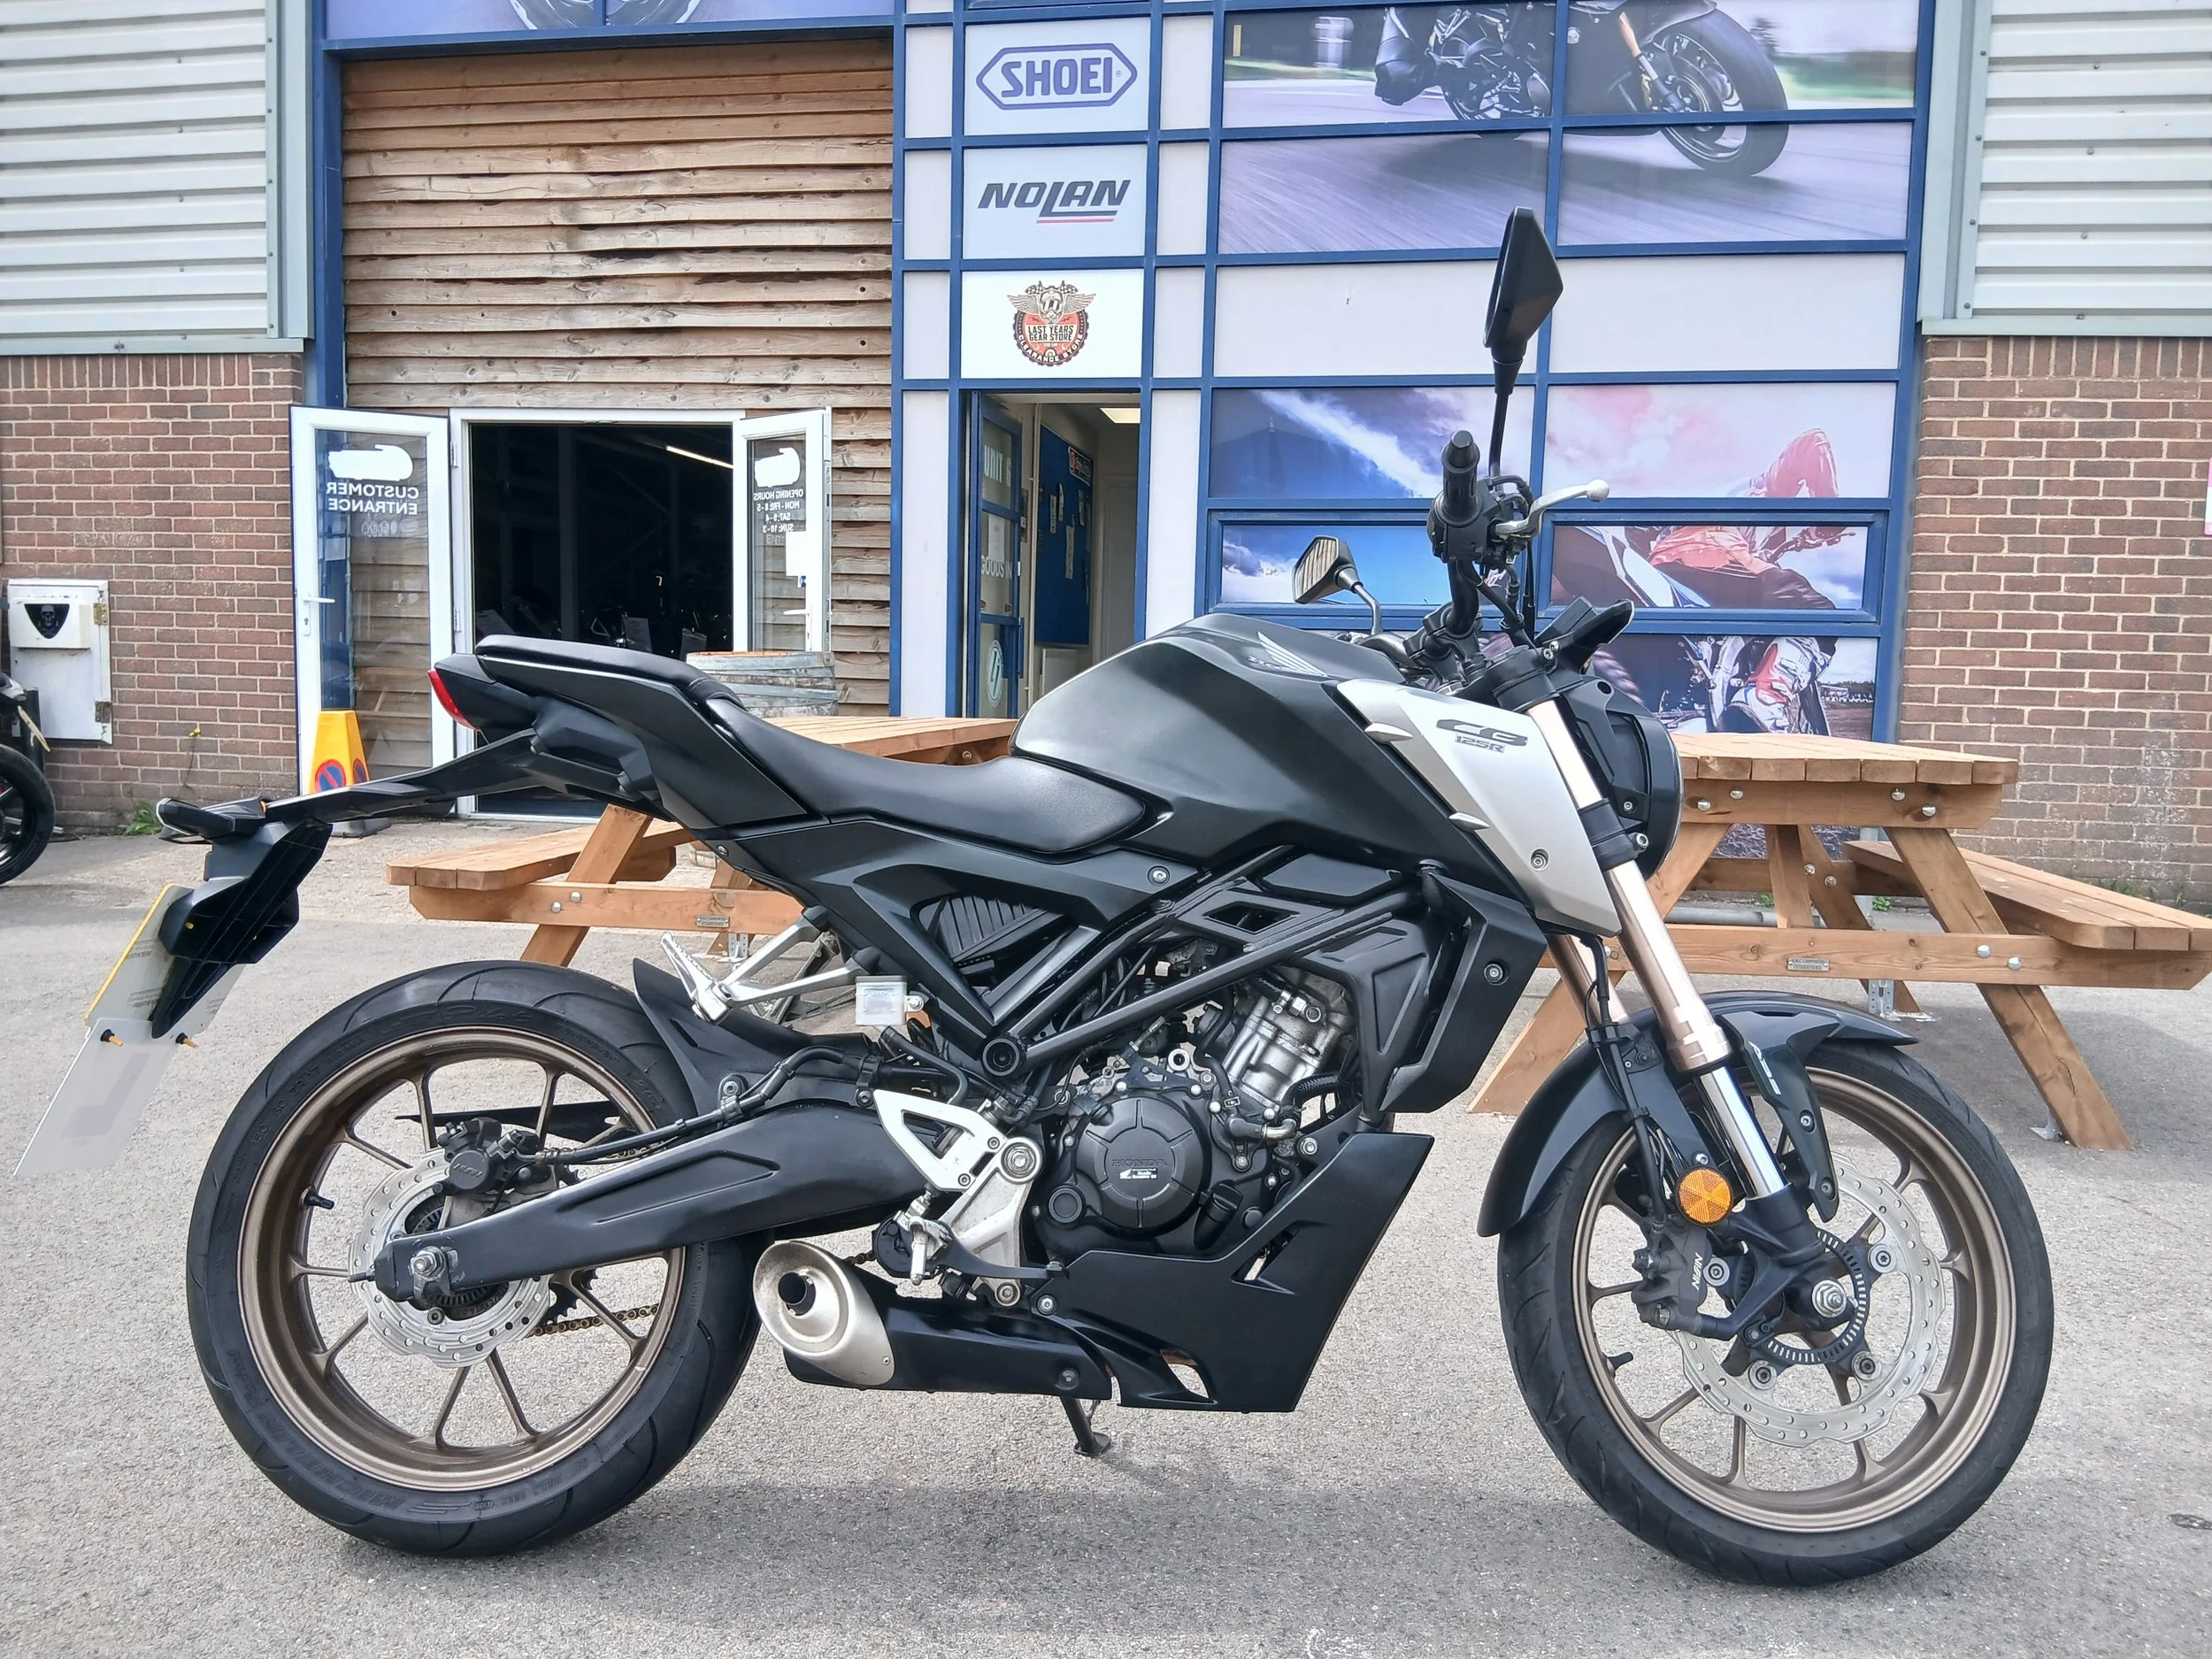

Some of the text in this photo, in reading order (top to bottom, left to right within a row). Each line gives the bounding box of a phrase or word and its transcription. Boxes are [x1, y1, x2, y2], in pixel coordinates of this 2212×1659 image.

[1001, 57, 1113, 98] SHOEI
[977, 180, 1132, 218] NOLAN
[1027, 325, 1074, 334] LAST YEARS
[1049, 333, 1072, 342] STORE
[1018, 333, 1083, 363] CLEARANCE STORE
[984, 444, 1003, 483] UNIT
[980, 554, 1004, 579] GOODS
[1436, 718, 1529, 747] CB
[1455, 733, 1506, 754] 125R
[1111, 1157, 1169, 1167] HONDA
[1691, 1251, 1703, 1291] NISSIN
[258, 1413, 407, 1511] MICHELIN
